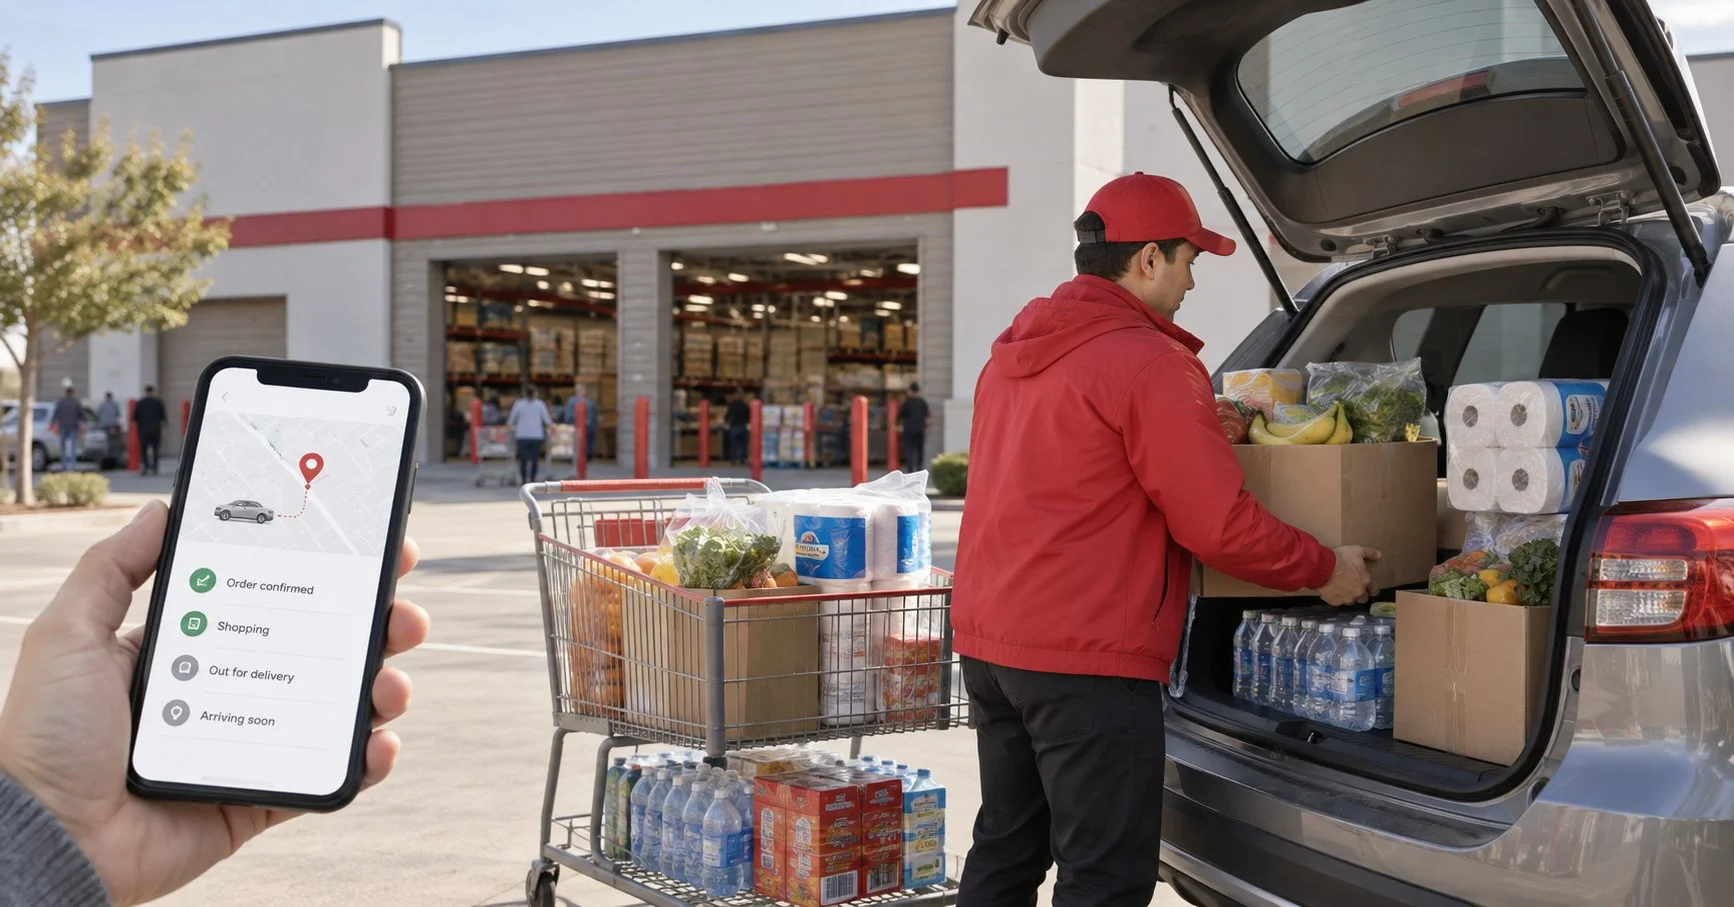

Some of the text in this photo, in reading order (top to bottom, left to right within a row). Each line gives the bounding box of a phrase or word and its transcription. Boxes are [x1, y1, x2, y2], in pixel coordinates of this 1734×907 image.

[227, 578, 314, 595] Order confirmed
[217, 621, 270, 637] Shopping
[209, 666, 295, 684] Out for delivery
[200, 711, 275, 727] Arriving soon
